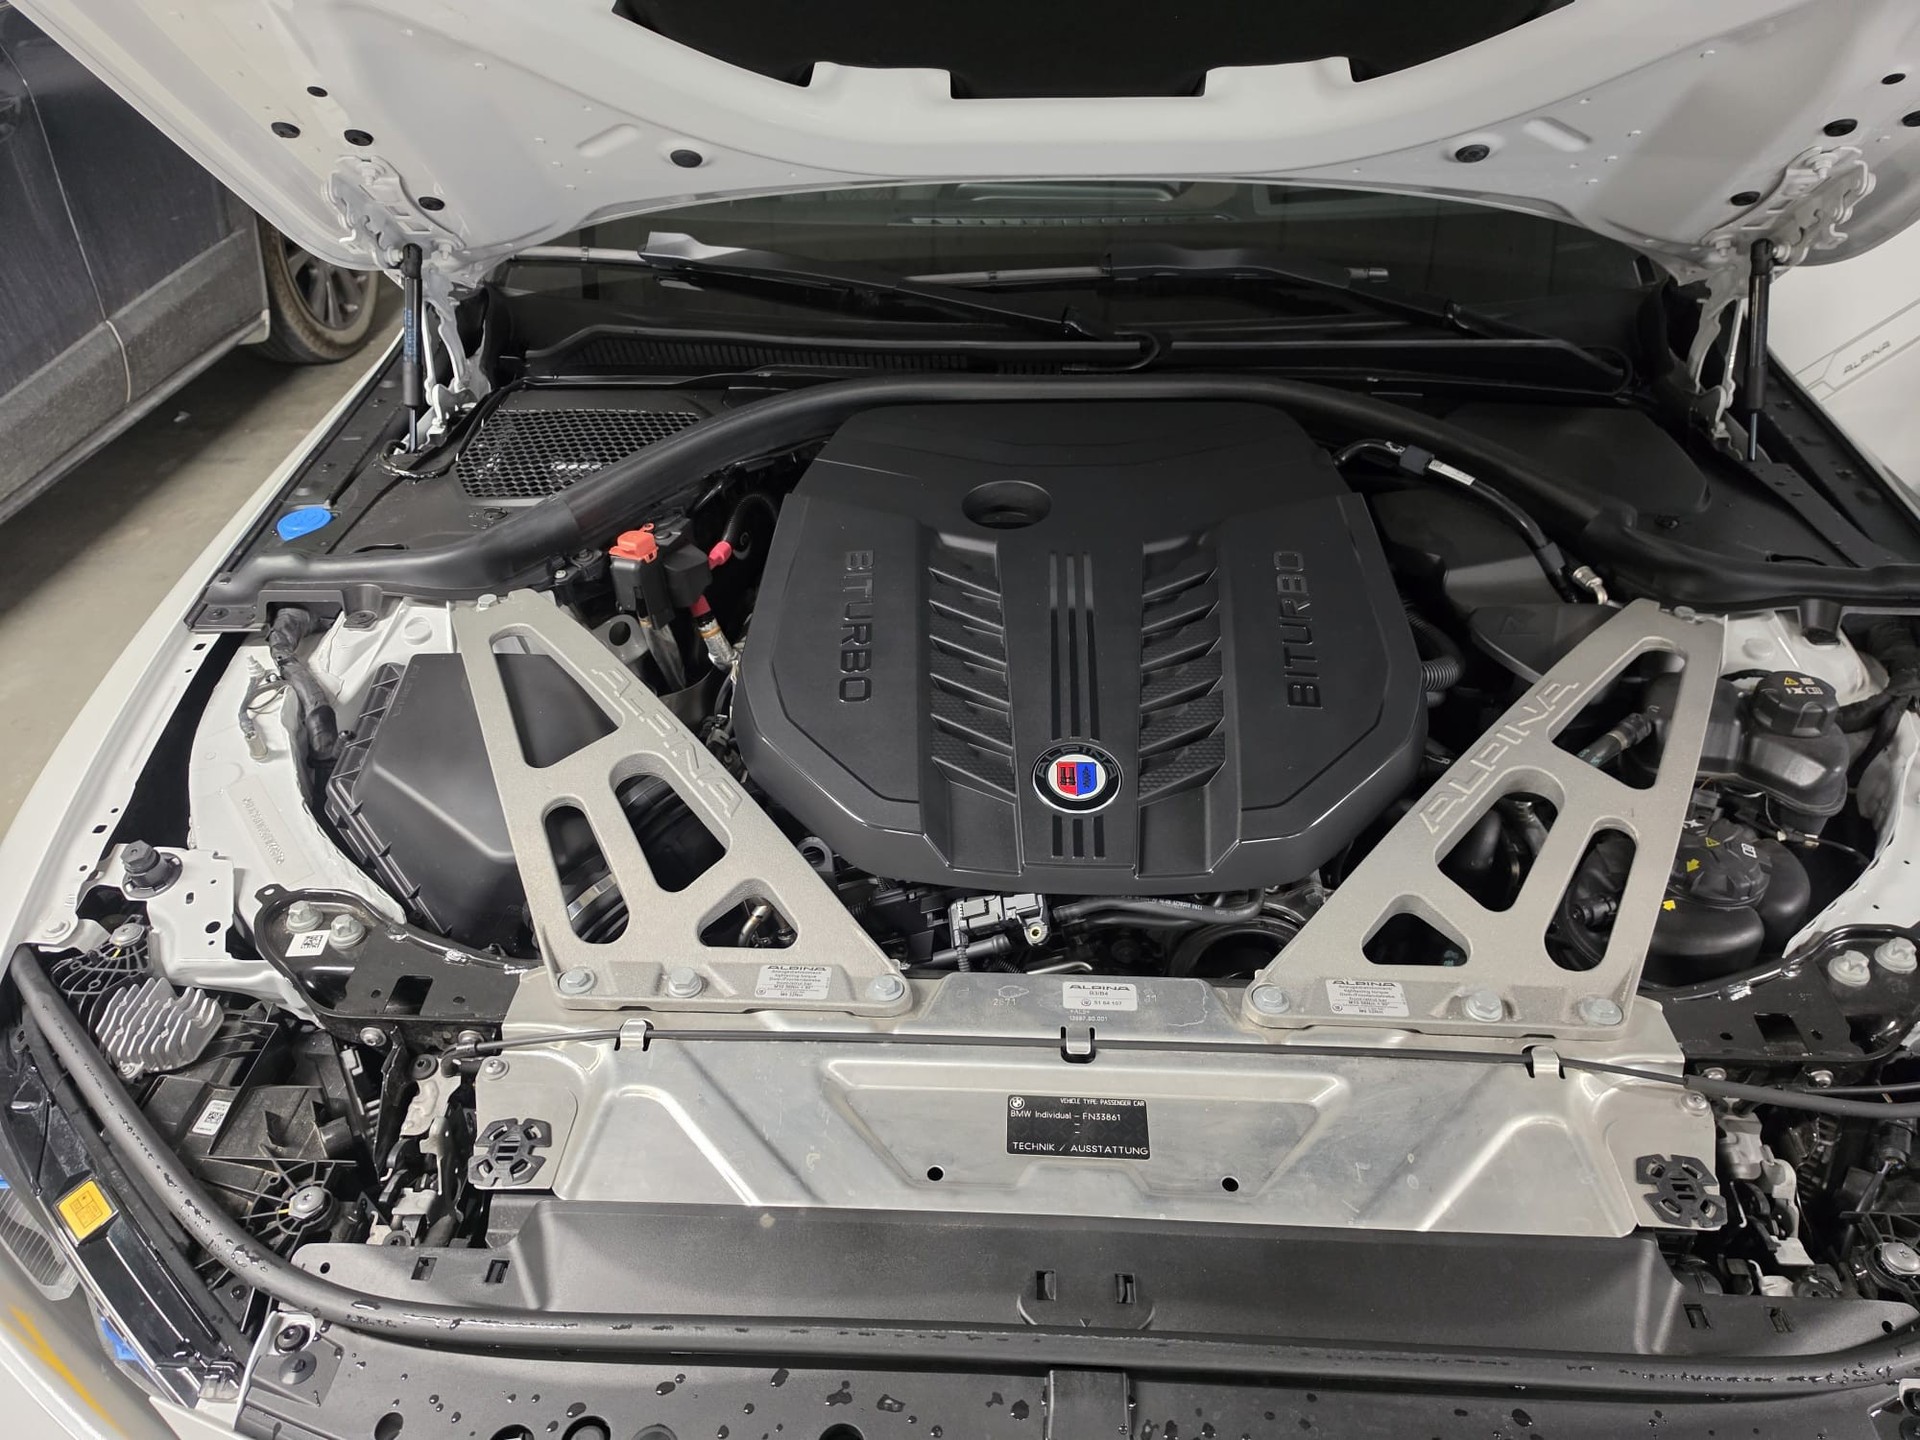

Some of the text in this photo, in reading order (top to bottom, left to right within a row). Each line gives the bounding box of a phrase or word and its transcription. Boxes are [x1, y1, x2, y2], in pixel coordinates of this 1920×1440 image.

[1843, 340, 1890, 375] ALPINA
[838, 550, 875, 703] BITURBO
[1273, 551, 1324, 709] BITURBO
[591, 667, 743, 819] ALPINA
[1036, 744, 1118, 779] ALPINA
[1419, 682, 1580, 834] ALPINA
[1010, 1110, 1032, 1118] BMW
[1035, 1110, 1072, 1119] Individual
[1082, 1112, 1121, 1121] FN33861
[1013, 1141, 1056, 1152] TECHNIK
[1070, 1144, 1149, 1155] AUSSTATTUNG
